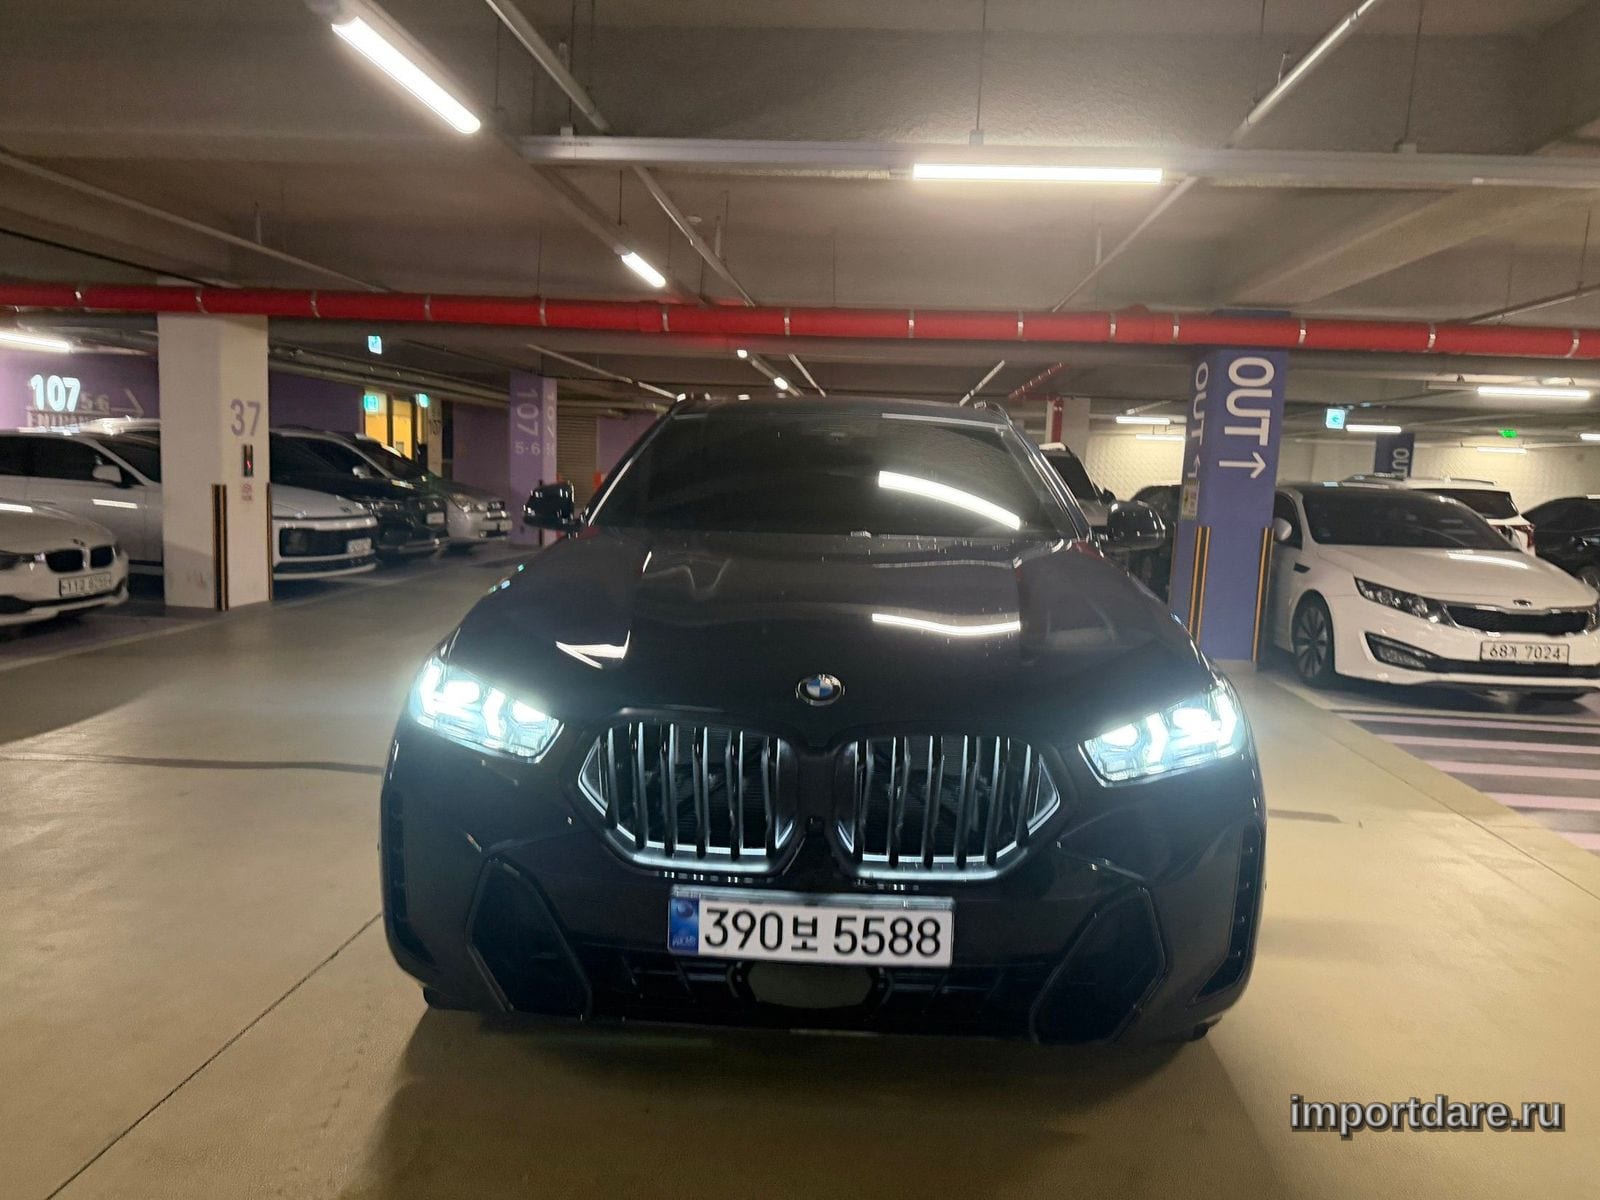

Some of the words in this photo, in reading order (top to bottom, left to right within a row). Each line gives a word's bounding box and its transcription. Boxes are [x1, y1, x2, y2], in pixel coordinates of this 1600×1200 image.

[30, 374, 81, 412] 107
[516, 388, 539, 437] 107
[1191, 361, 1209, 446] OUT
[1224, 357, 1275, 446] OUT
[230, 399, 261, 438] 37
[1525, 646, 1561, 660] 7024
[704, 907, 818, 952] 390보
[833, 915, 941, 957] 5588
